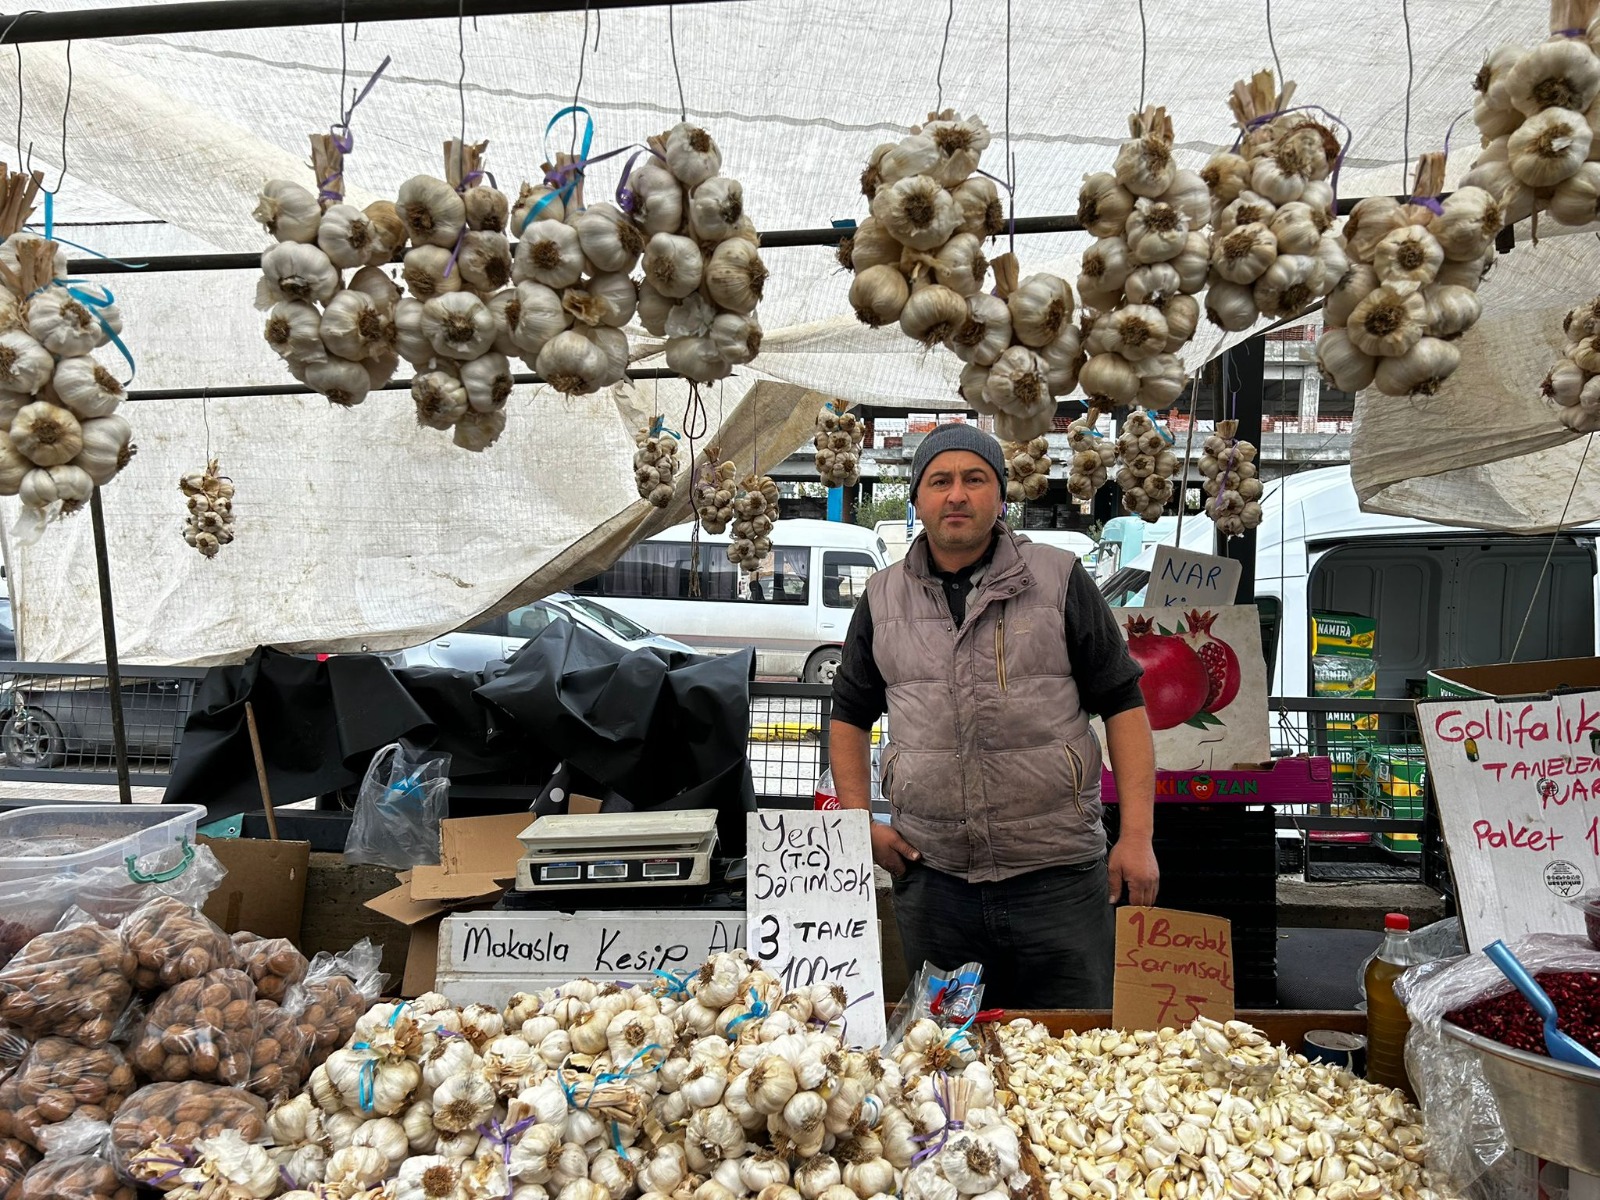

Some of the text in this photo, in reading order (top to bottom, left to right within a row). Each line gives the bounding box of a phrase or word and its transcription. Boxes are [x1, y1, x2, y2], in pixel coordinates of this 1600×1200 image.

[1161, 557, 1222, 590] NAR
[1317, 623, 1351, 638] NAMIRA
[1473, 818, 1564, 852] Paket
[462, 926, 570, 963] Makasla
[756, 914, 868, 961] 3 TANE
[1128, 910, 1145, 949] 1
[1151, 982, 1209, 1025] 75
